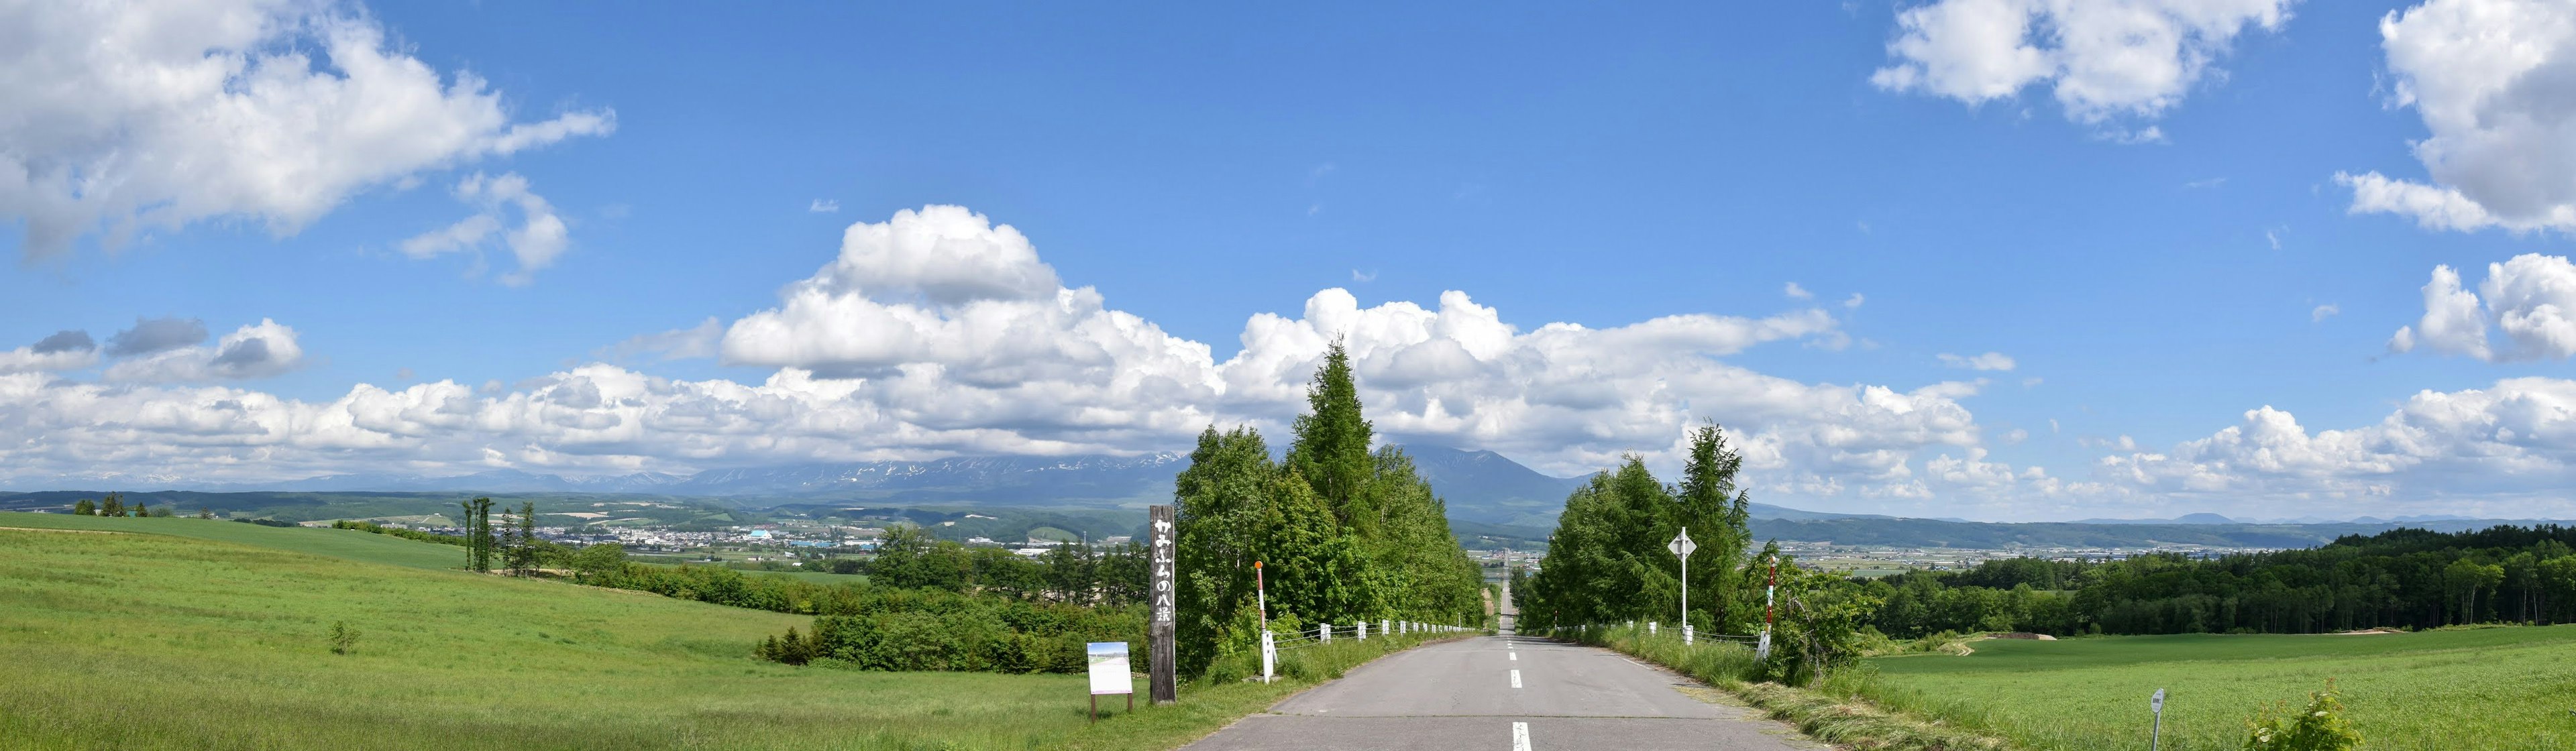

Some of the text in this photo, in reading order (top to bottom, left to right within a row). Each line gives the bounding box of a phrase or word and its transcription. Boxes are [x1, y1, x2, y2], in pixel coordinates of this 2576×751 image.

[1155, 519, 1172, 622] かみふらの八景
